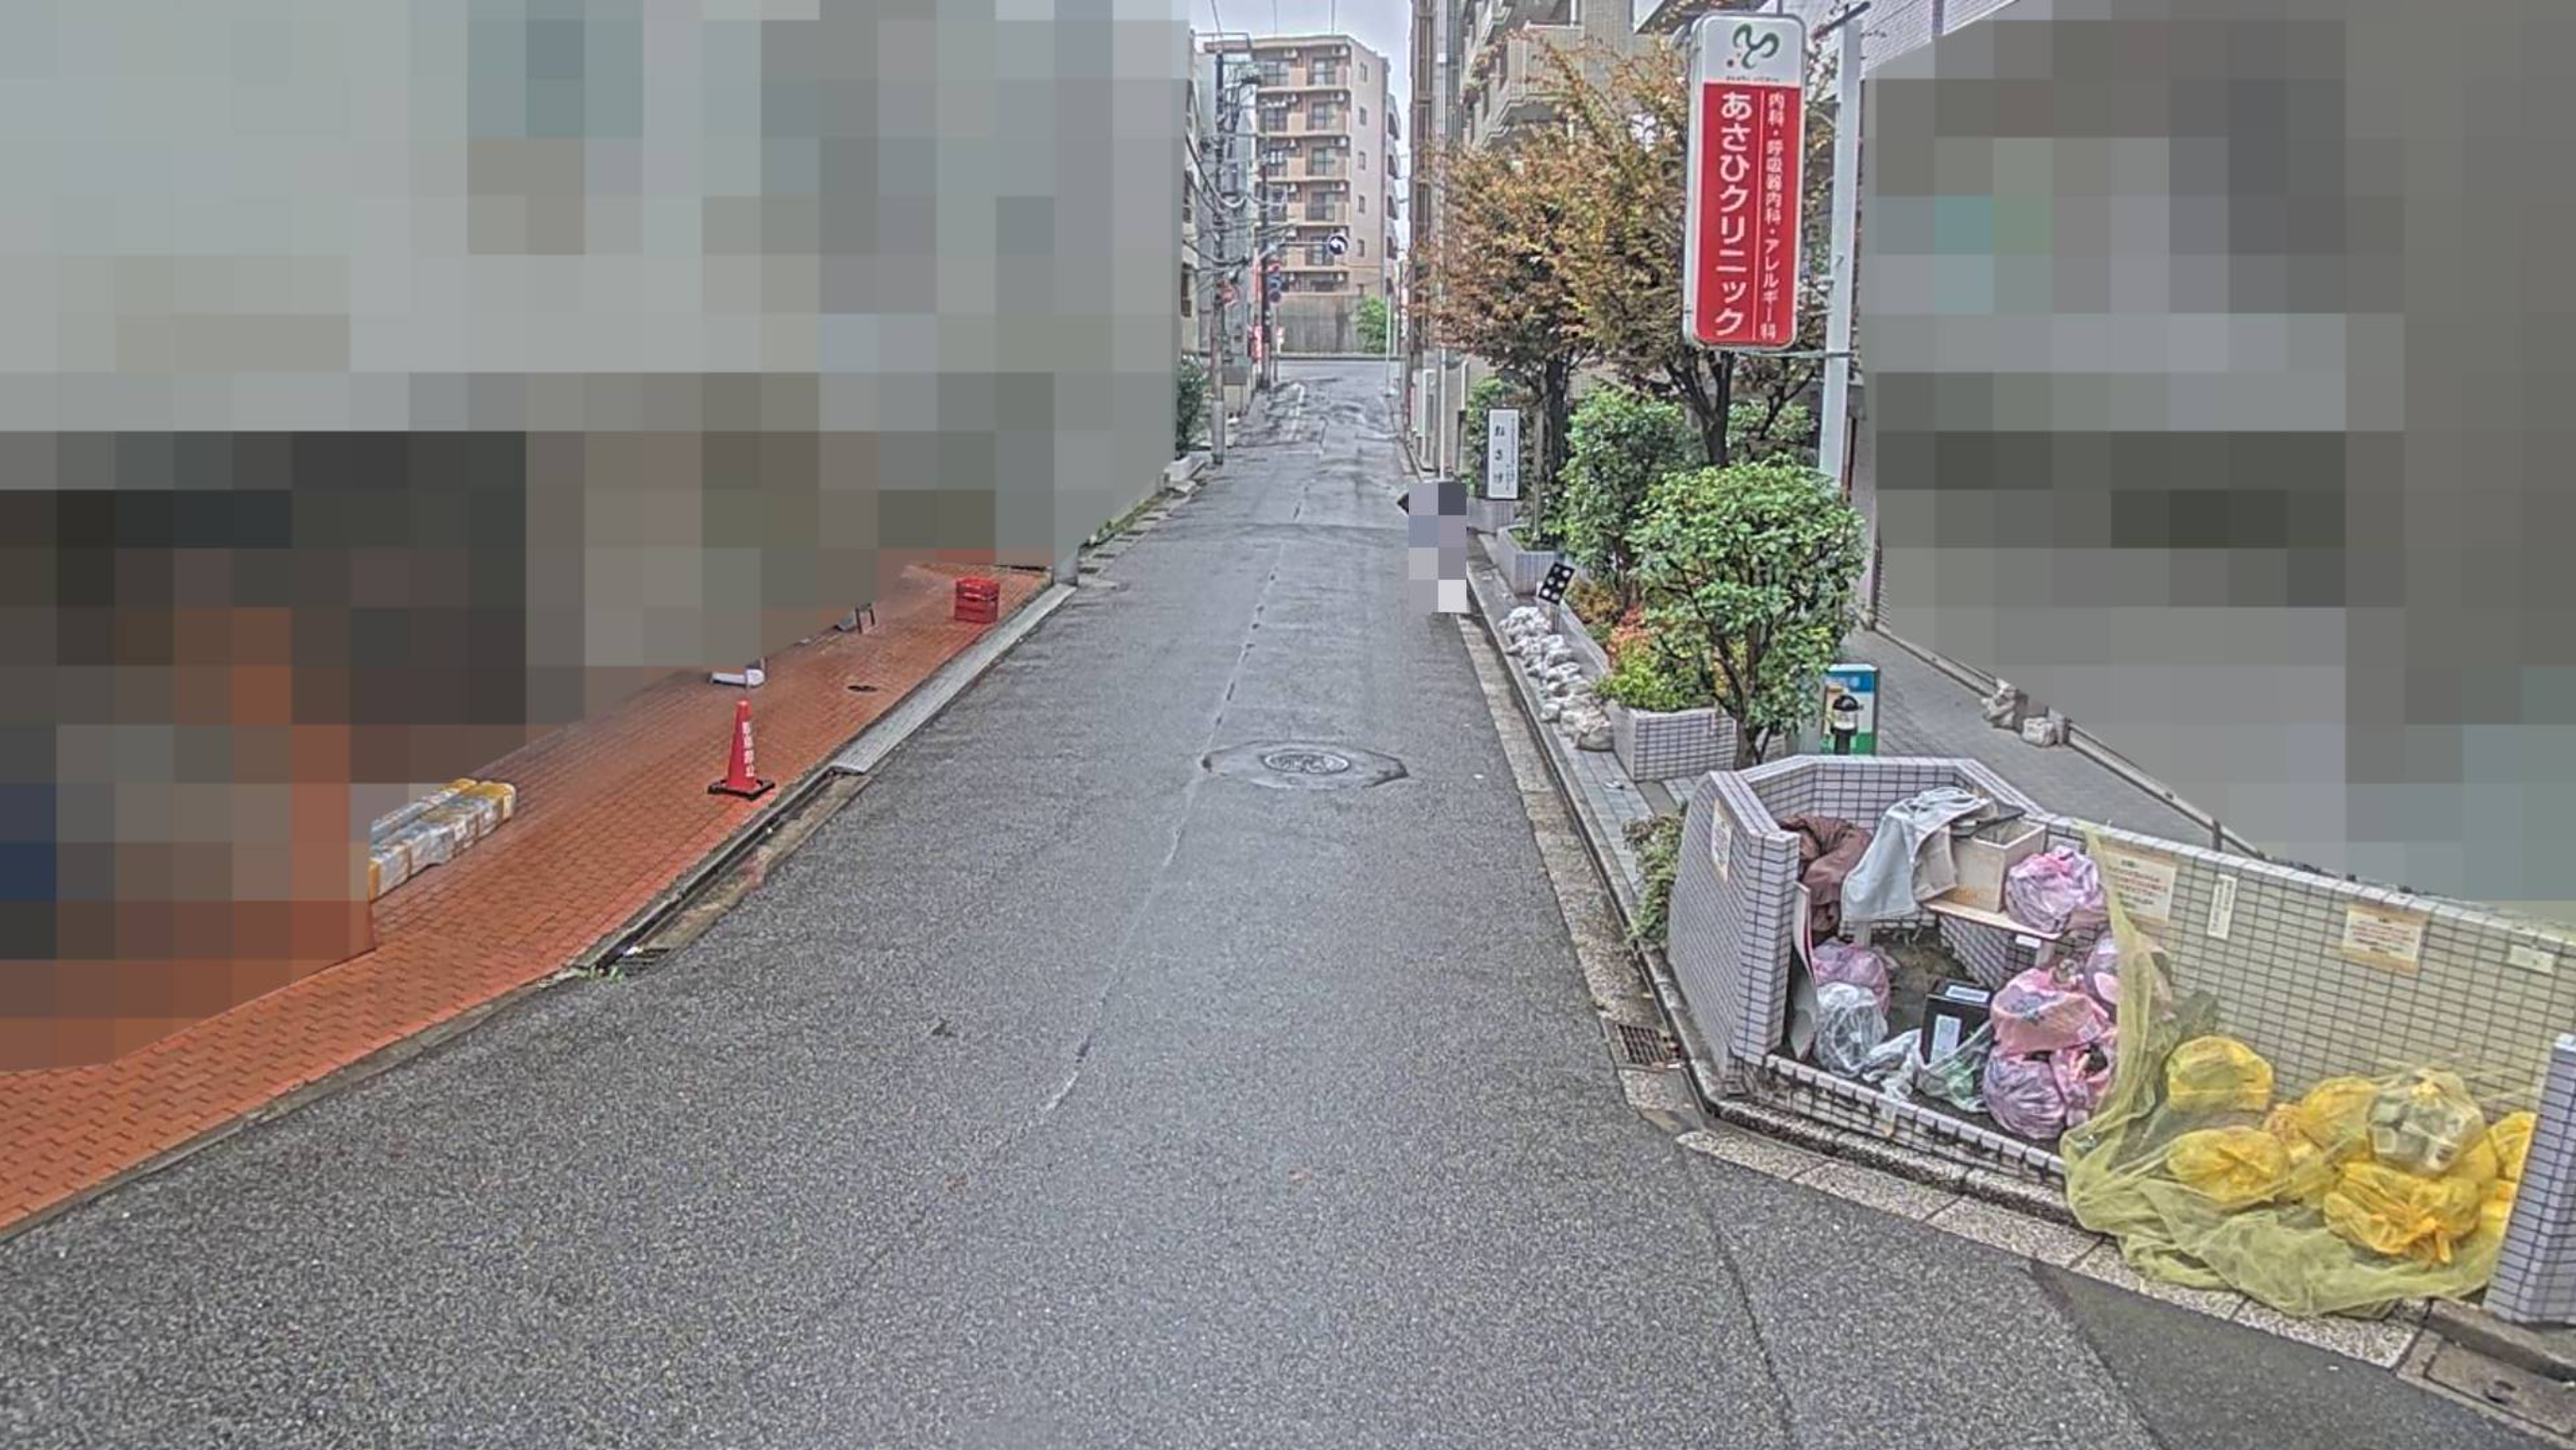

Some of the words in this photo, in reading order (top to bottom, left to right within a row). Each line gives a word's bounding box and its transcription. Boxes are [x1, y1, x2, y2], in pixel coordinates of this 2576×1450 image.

[1716, 92, 1753, 336] あさひクリニック
